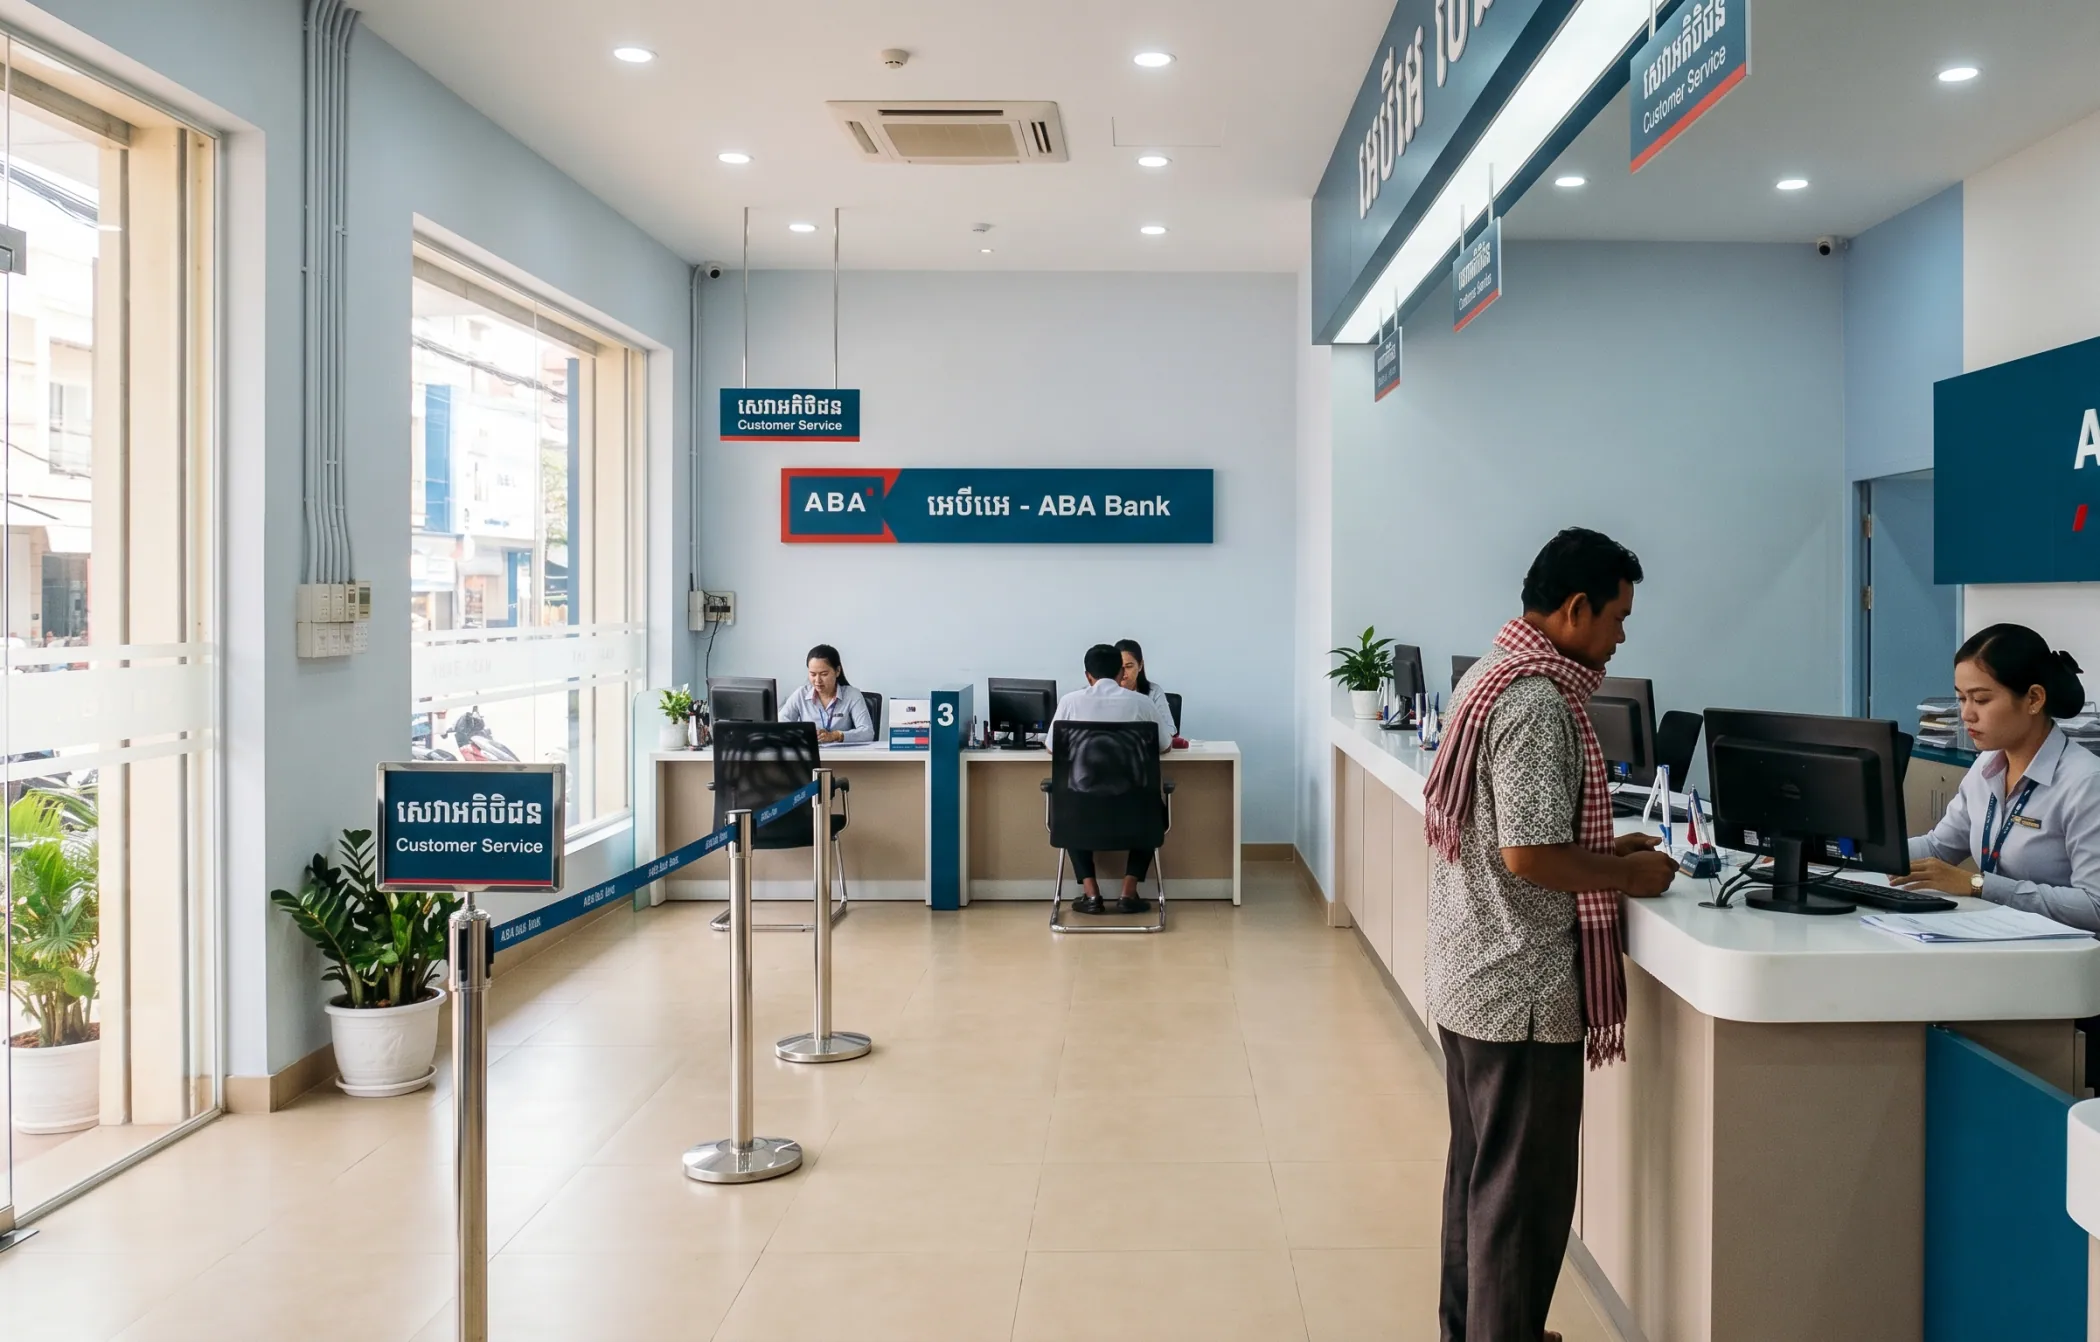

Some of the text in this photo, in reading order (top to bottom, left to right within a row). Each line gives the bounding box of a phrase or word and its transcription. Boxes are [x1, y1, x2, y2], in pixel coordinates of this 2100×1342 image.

[1643, 45, 1726, 134] Customer Service
[737, 419, 843, 431] Customer Service
[804, 492, 866, 512] ABA
[1037, 495, 1096, 516] ABA
[1105, 495, 1171, 516] Bank
[937, 702, 954, 727] 3
[396, 837, 544, 855] Customer Service
